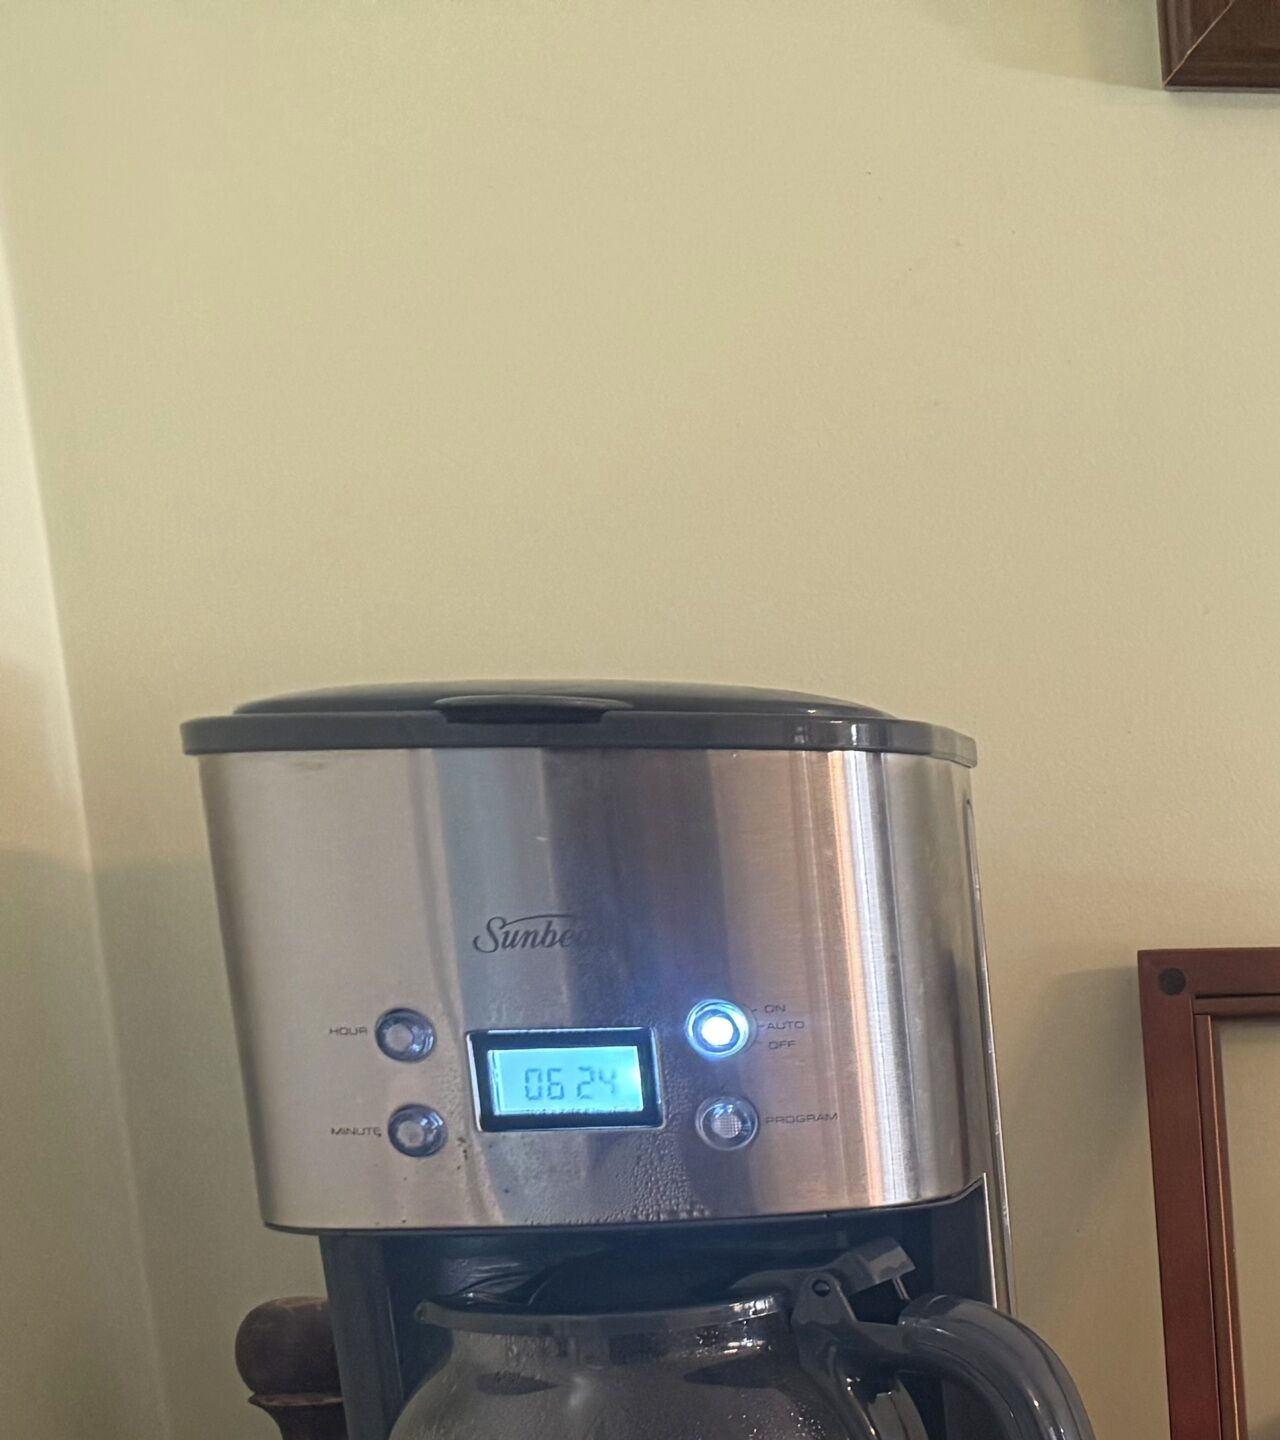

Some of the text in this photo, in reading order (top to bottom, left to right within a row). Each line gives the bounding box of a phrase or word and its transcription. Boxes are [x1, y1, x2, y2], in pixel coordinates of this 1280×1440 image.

[764, 1004, 786, 1014] ON
[767, 1020, 805, 1030] AUTO
[329, 1026, 368, 1036] HOUR
[768, 1040, 796, 1050] OFF
[765, 1112, 838, 1124] PROGRAM
[331, 1127, 382, 1138] MINUTE
